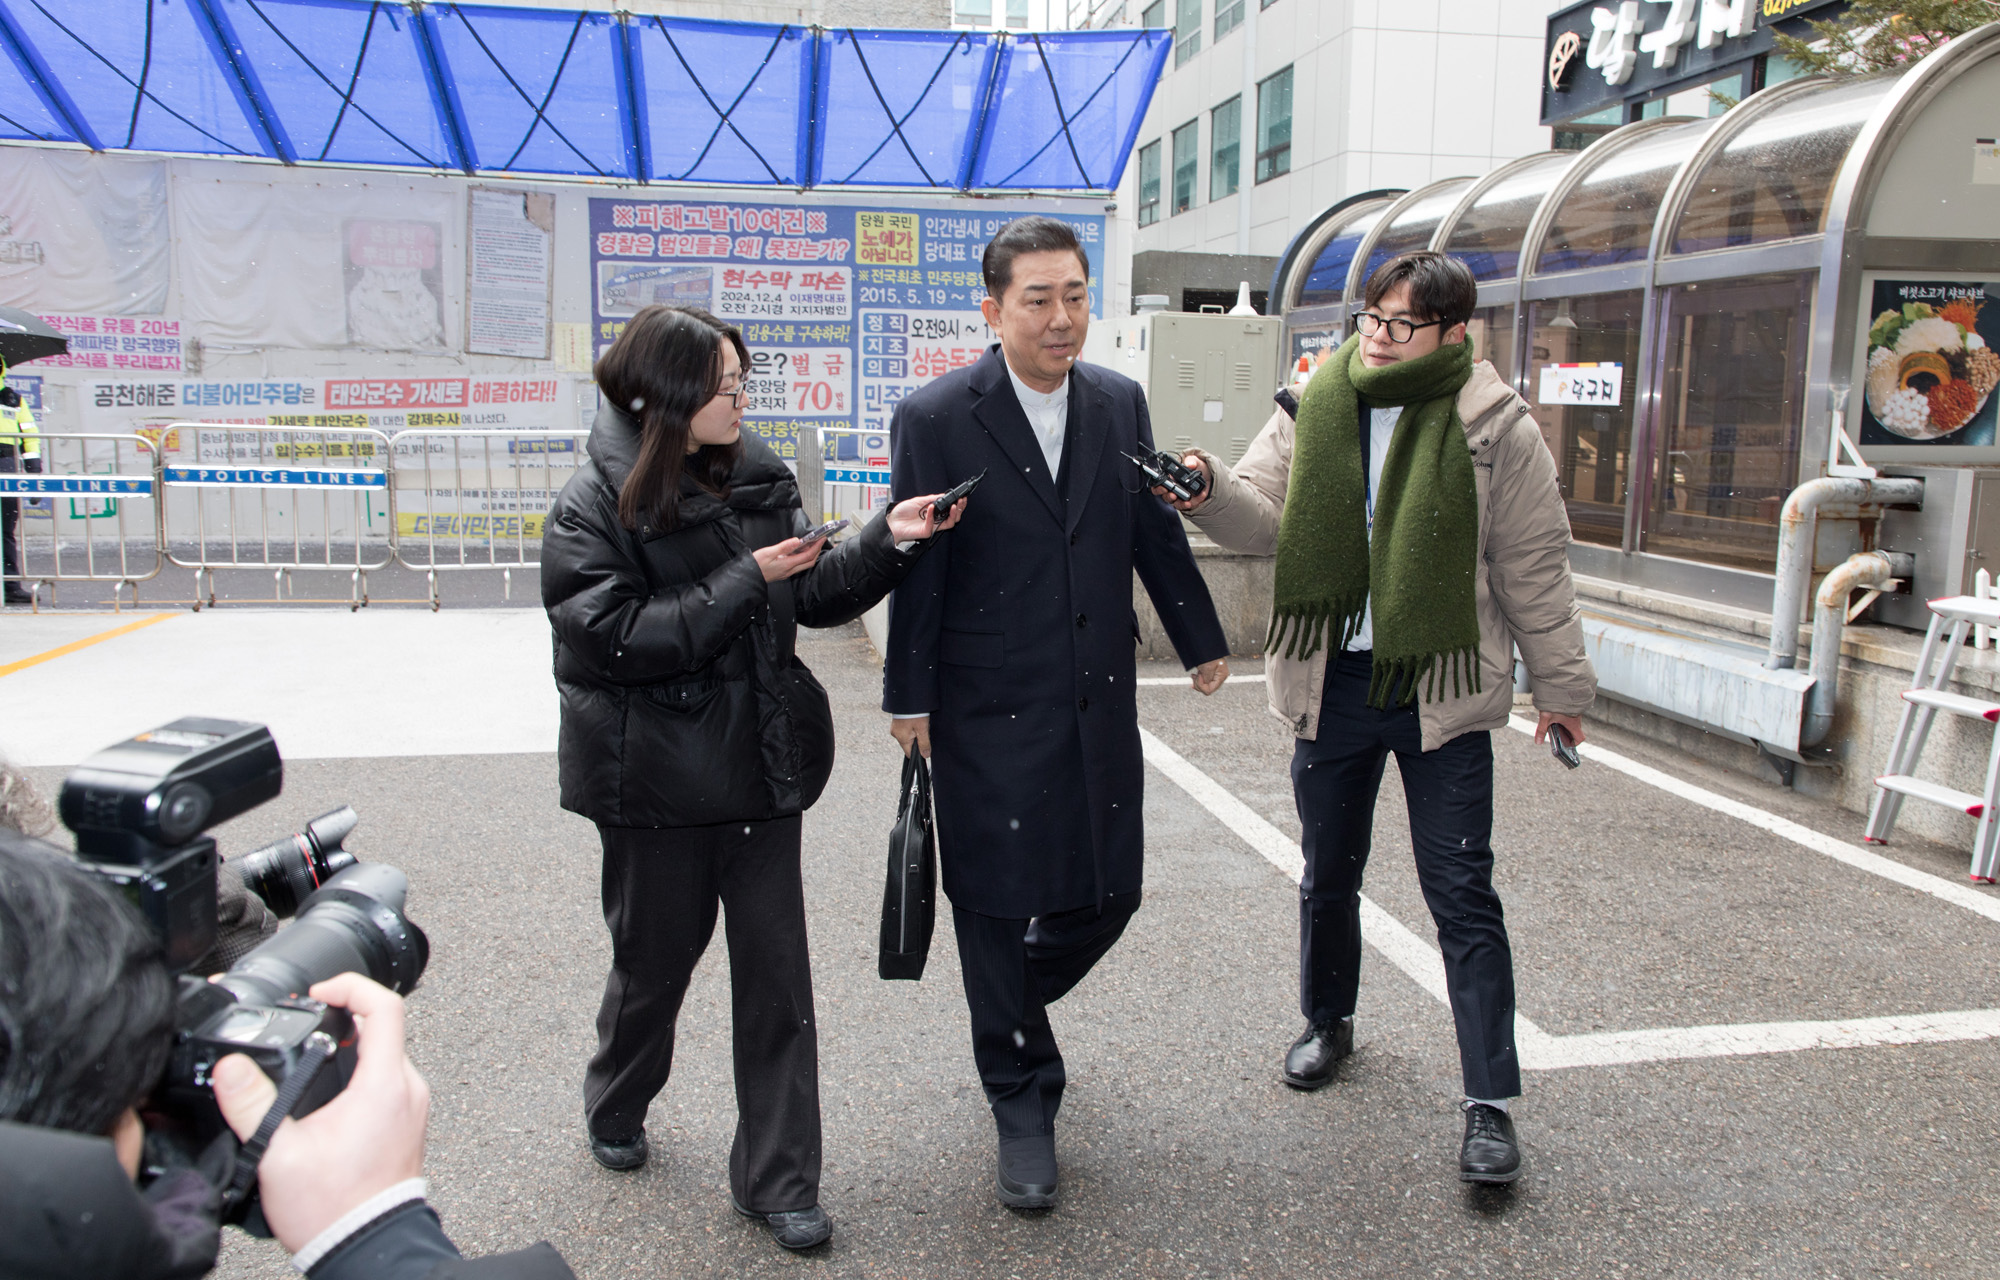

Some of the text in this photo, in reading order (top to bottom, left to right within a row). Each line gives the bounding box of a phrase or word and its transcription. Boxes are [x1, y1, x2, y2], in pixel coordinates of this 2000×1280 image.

[860, 214, 912, 228] 당원 국민
[924, 217, 980, 239] 인간냄새
[597, 233, 850, 260] 경찰은 범인들을 왜! 못잡는가?
[860, 229, 914, 249] 노예가
[860, 248, 914, 263] 아닙니다
[924, 241, 987, 263] 당대표 대
[722, 268, 846, 290] 현수막 파손
[720, 291, 782, 303] 2024.12.4
[789, 293, 847, 304] 이재명대표
[859, 287, 902, 304] 2015.
[907, 288, 922, 304] 5.
[927, 289, 947, 304] 19
[970, 289, 988, 306] 현
[1899, 285, 1985, 300] 버섯소고기 샤브샤브
[720, 303, 783, 316] 오전 2시경
[789, 304, 847, 317] 지지자범인
[38, 315, 180, 336] 정식품 유통 20년
[747, 323, 796, 343] 김용수를
[798, 324, 851, 343] 구속하라!
[911, 318, 960, 340] 오전9시
[122, 335, 181, 354] 망국행위
[113, 353, 182, 371] 뿌리뽑자
[94, 380, 558, 407] 공천해준 더불어민주당은 태안군수 가세로 해결하라!!
[746, 379, 787, 394] 중앙당
[792, 381, 833, 411] 70
[864, 383, 920, 412] 민주
[62, 480, 119, 492] LINE
[199, 469, 356, 484] POLICE LINE
[835, 470, 892, 483] POLI
